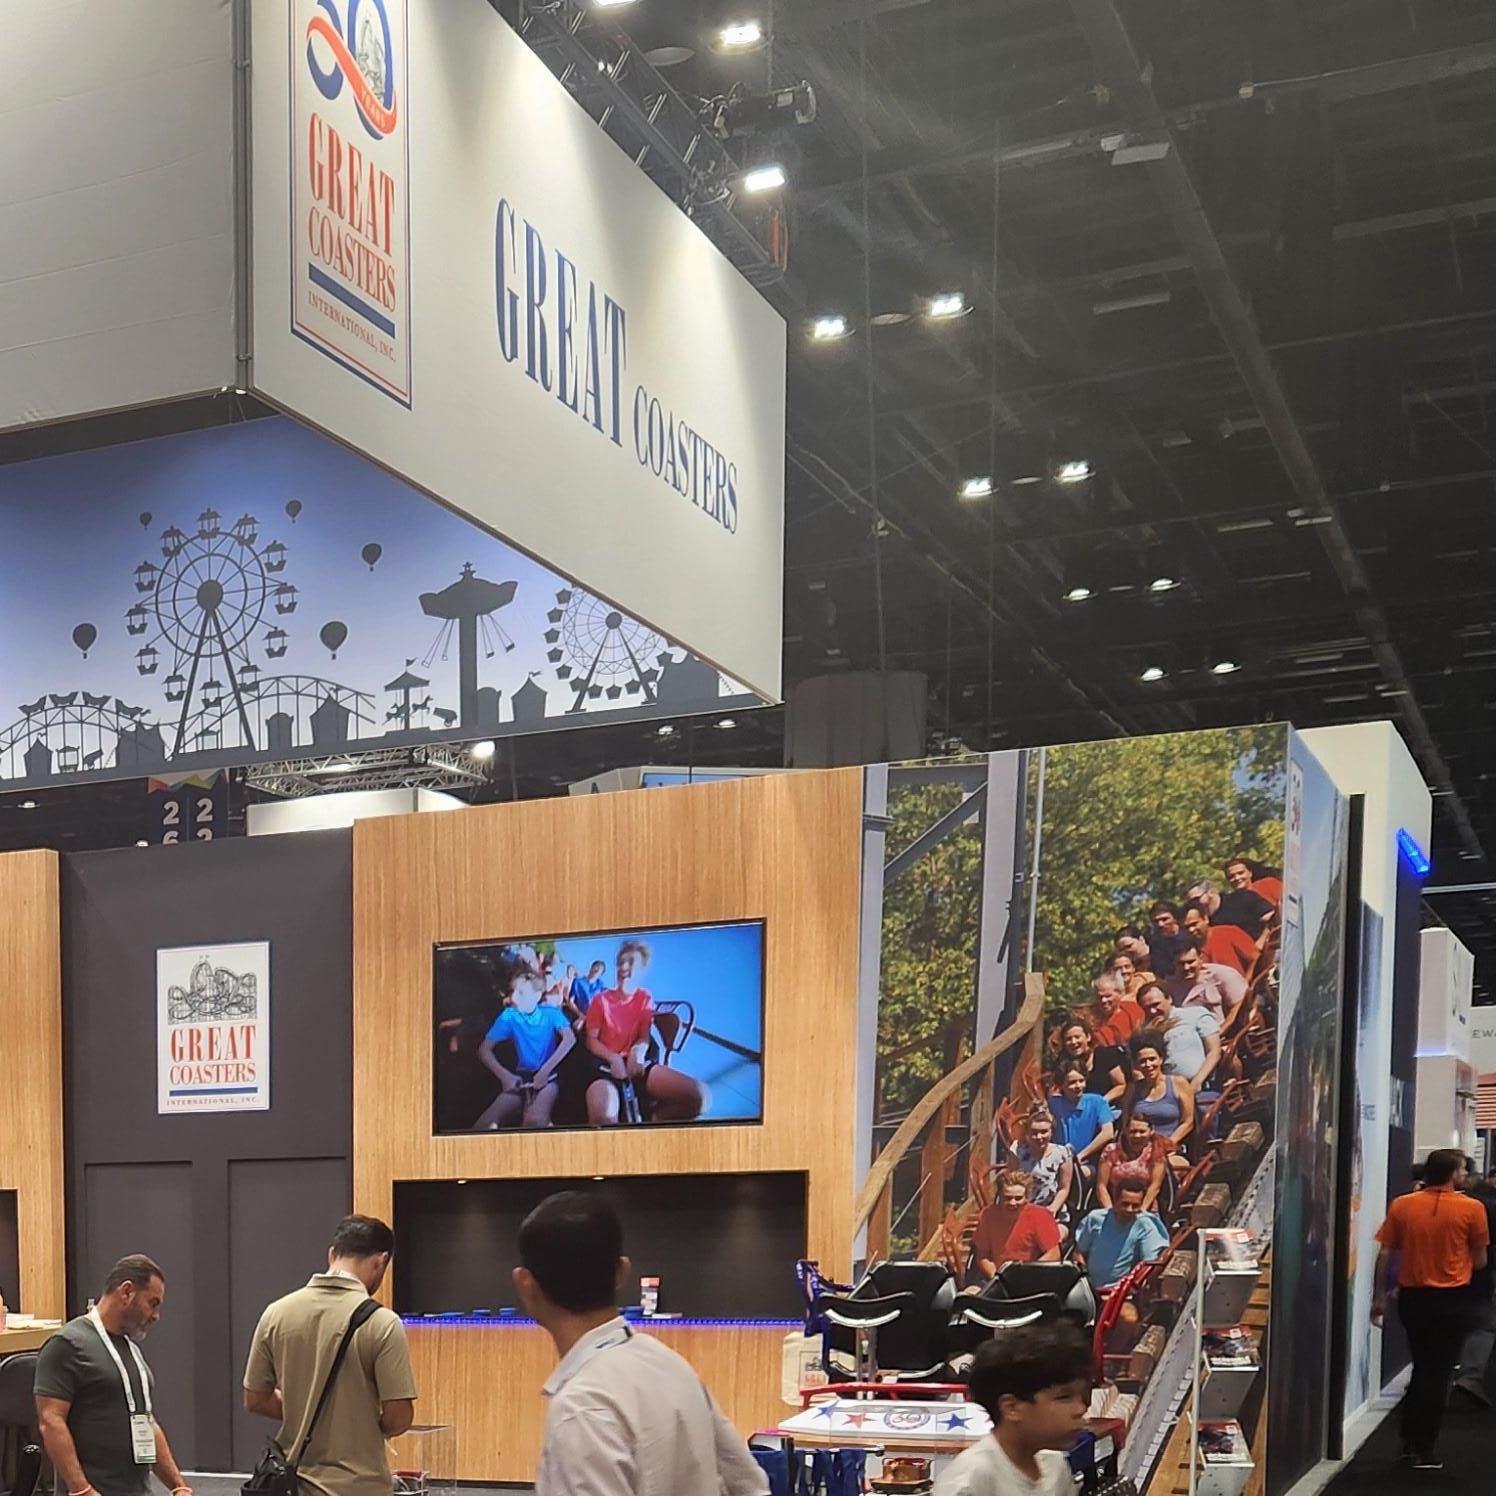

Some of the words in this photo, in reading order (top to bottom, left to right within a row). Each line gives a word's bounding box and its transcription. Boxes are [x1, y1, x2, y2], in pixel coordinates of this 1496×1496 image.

[308, 112, 396, 257] GREAT
[308, 206, 397, 312] COASTERS
[308, 292, 377, 354] INTERNATIONAL,
[379, 339, 397, 362] INC.
[495, 198, 627, 447] GREAT
[634, 385, 738, 534] COASTERS
[170, 1024, 256, 1062] GREAT
[1473, 1029, 1496, 1038] EW
[169, 1062, 256, 1085] COASTERS
